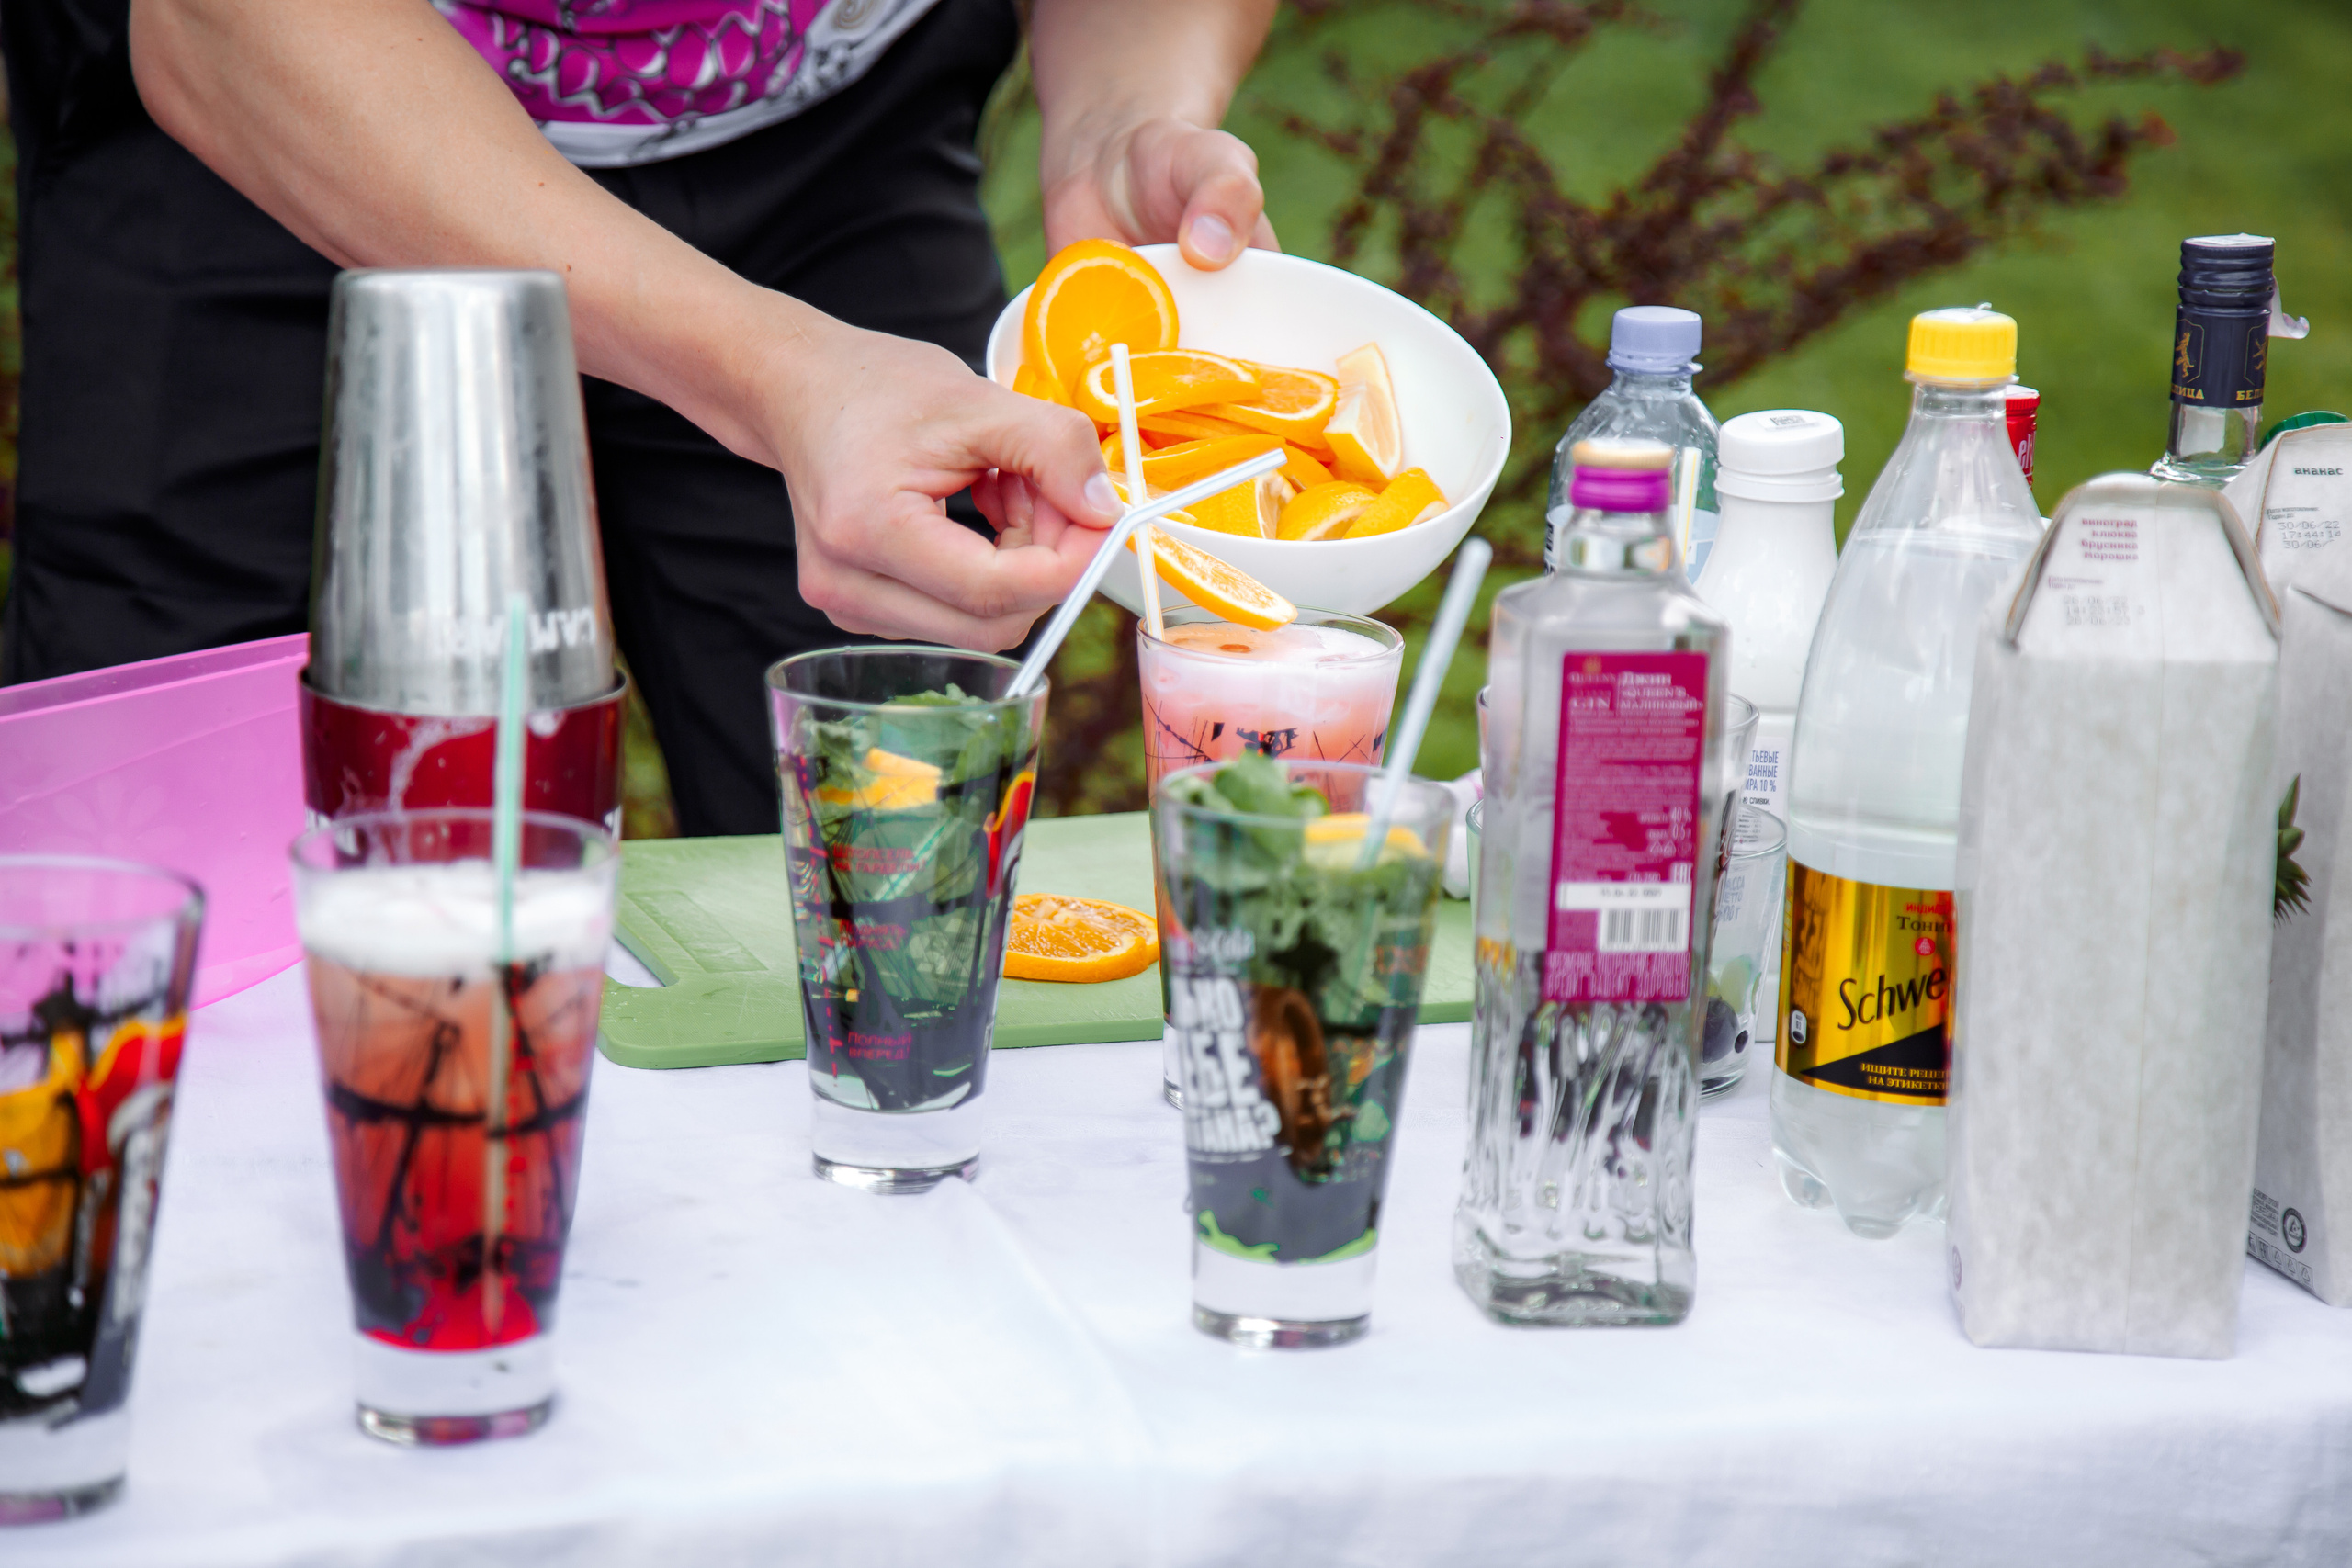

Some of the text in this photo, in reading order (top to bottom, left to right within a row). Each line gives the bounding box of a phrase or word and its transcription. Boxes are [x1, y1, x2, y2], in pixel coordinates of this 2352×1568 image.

[2293, 467, 2344, 476] ананас
[2081, 518, 2138, 528] виноград
[2278, 520, 2341, 530] 30/06/22
[2091, 530, 2138, 538] клюква
[2080, 539, 2139, 550] брусника
[2083, 551, 2140, 561] морошка
[1837, 967, 1947, 1031] Schwe
[1860, 1063, 1907, 1077] ИЩИТЕ
[1868, 1076, 1884, 1086] НА
